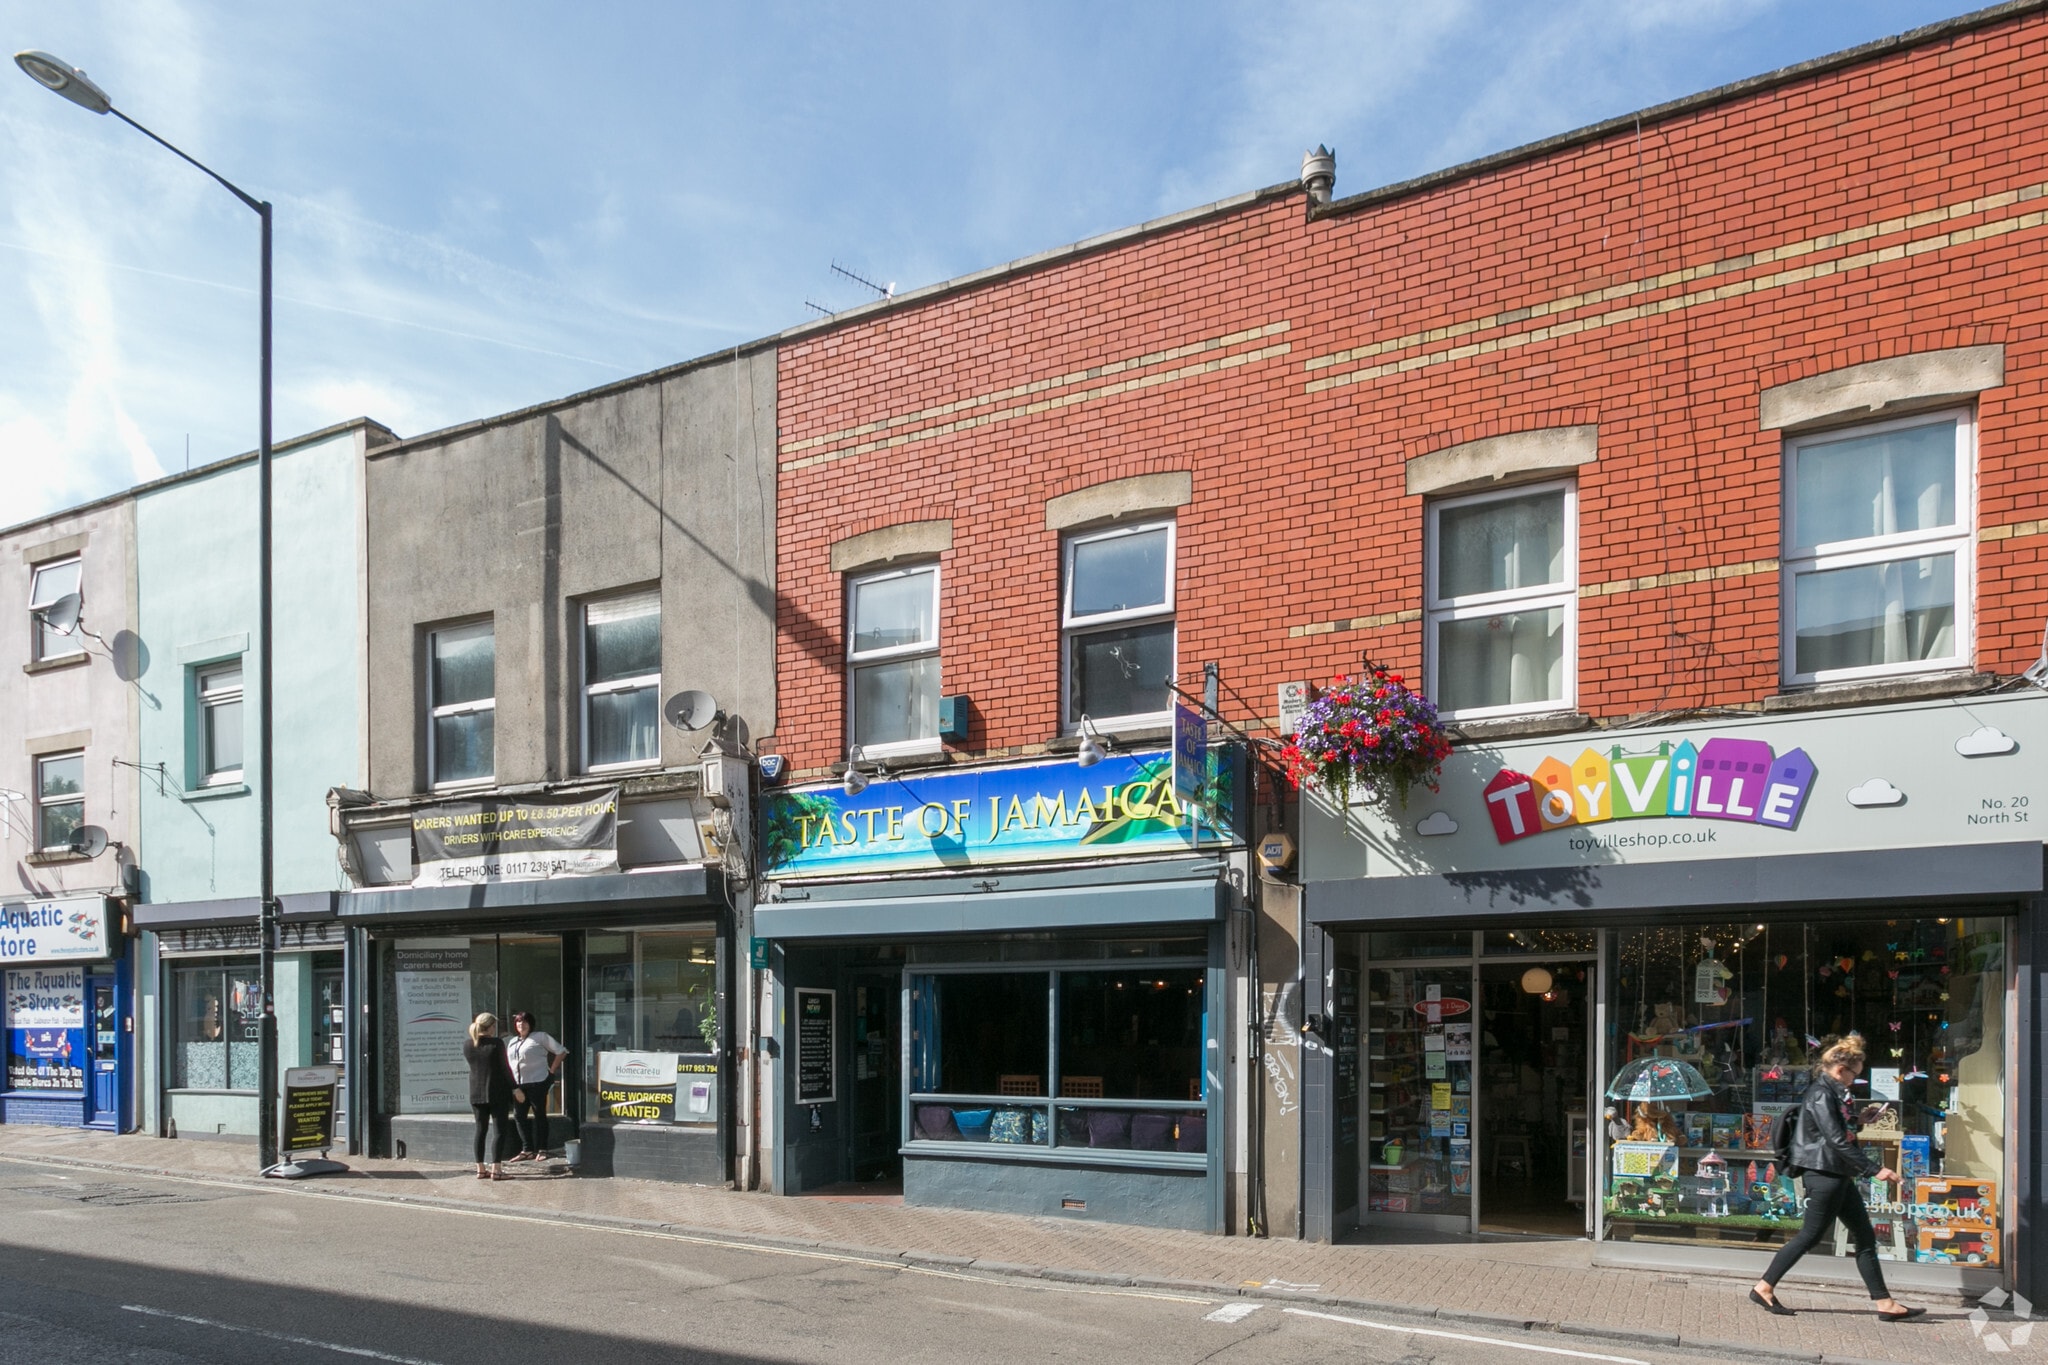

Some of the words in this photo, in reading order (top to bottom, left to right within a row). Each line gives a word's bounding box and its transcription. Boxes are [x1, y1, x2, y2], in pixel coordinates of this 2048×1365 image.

[1186, 739, 1196, 755] OF
[1982, 798, 2006, 809] No.
[2011, 796, 2029, 808] 20
[414, 816, 452, 830] CARERS
[454, 812, 496, 826] WANTED
[499, 810, 514, 822] UP
[516, 808, 528, 820] TO
[560, 806, 583, 818] PER
[585, 801, 616, 816] HOUR
[793, 806, 905, 849] TASTE
[917, 799, 971, 838] OF
[988, 779, 1183, 844] JAMAICA
[1968, 812, 2010, 824] North
[2014, 812, 2028, 822] St
[444, 833, 478, 846] DRIVERS
[480, 832, 502, 842] WITH
[504, 829, 526, 840] CARE
[527, 826, 579, 838] EXPERIENCE
[1569, 828, 1717, 852] toyvilleshop.co.uk
[1266, 845, 1282, 854] ADT
[506, 862, 528, 874] 0117
[0, 904, 63, 934] Aquatic
[0, 936, 36, 956] tore
[397, 952, 443, 960] Domiciliary
[8, 972, 30, 990] The
[35, 971, 82, 993] Aquatic
[29, 993, 60, 1010] Store
[26, 1066, 37, 1076] One
[46, 1066, 58, 1076] The
[616, 1066, 660, 1075] Homecare4u
[678, 1064, 692, 1072] 0117
[706, 1064, 717, 1072] 794
[61, 1078, 73, 1088] The
[602, 1090, 626, 1101] CARE
[628, 1092, 674, 1104] WORKERS
[611, 1105, 660, 1118] WANTED
